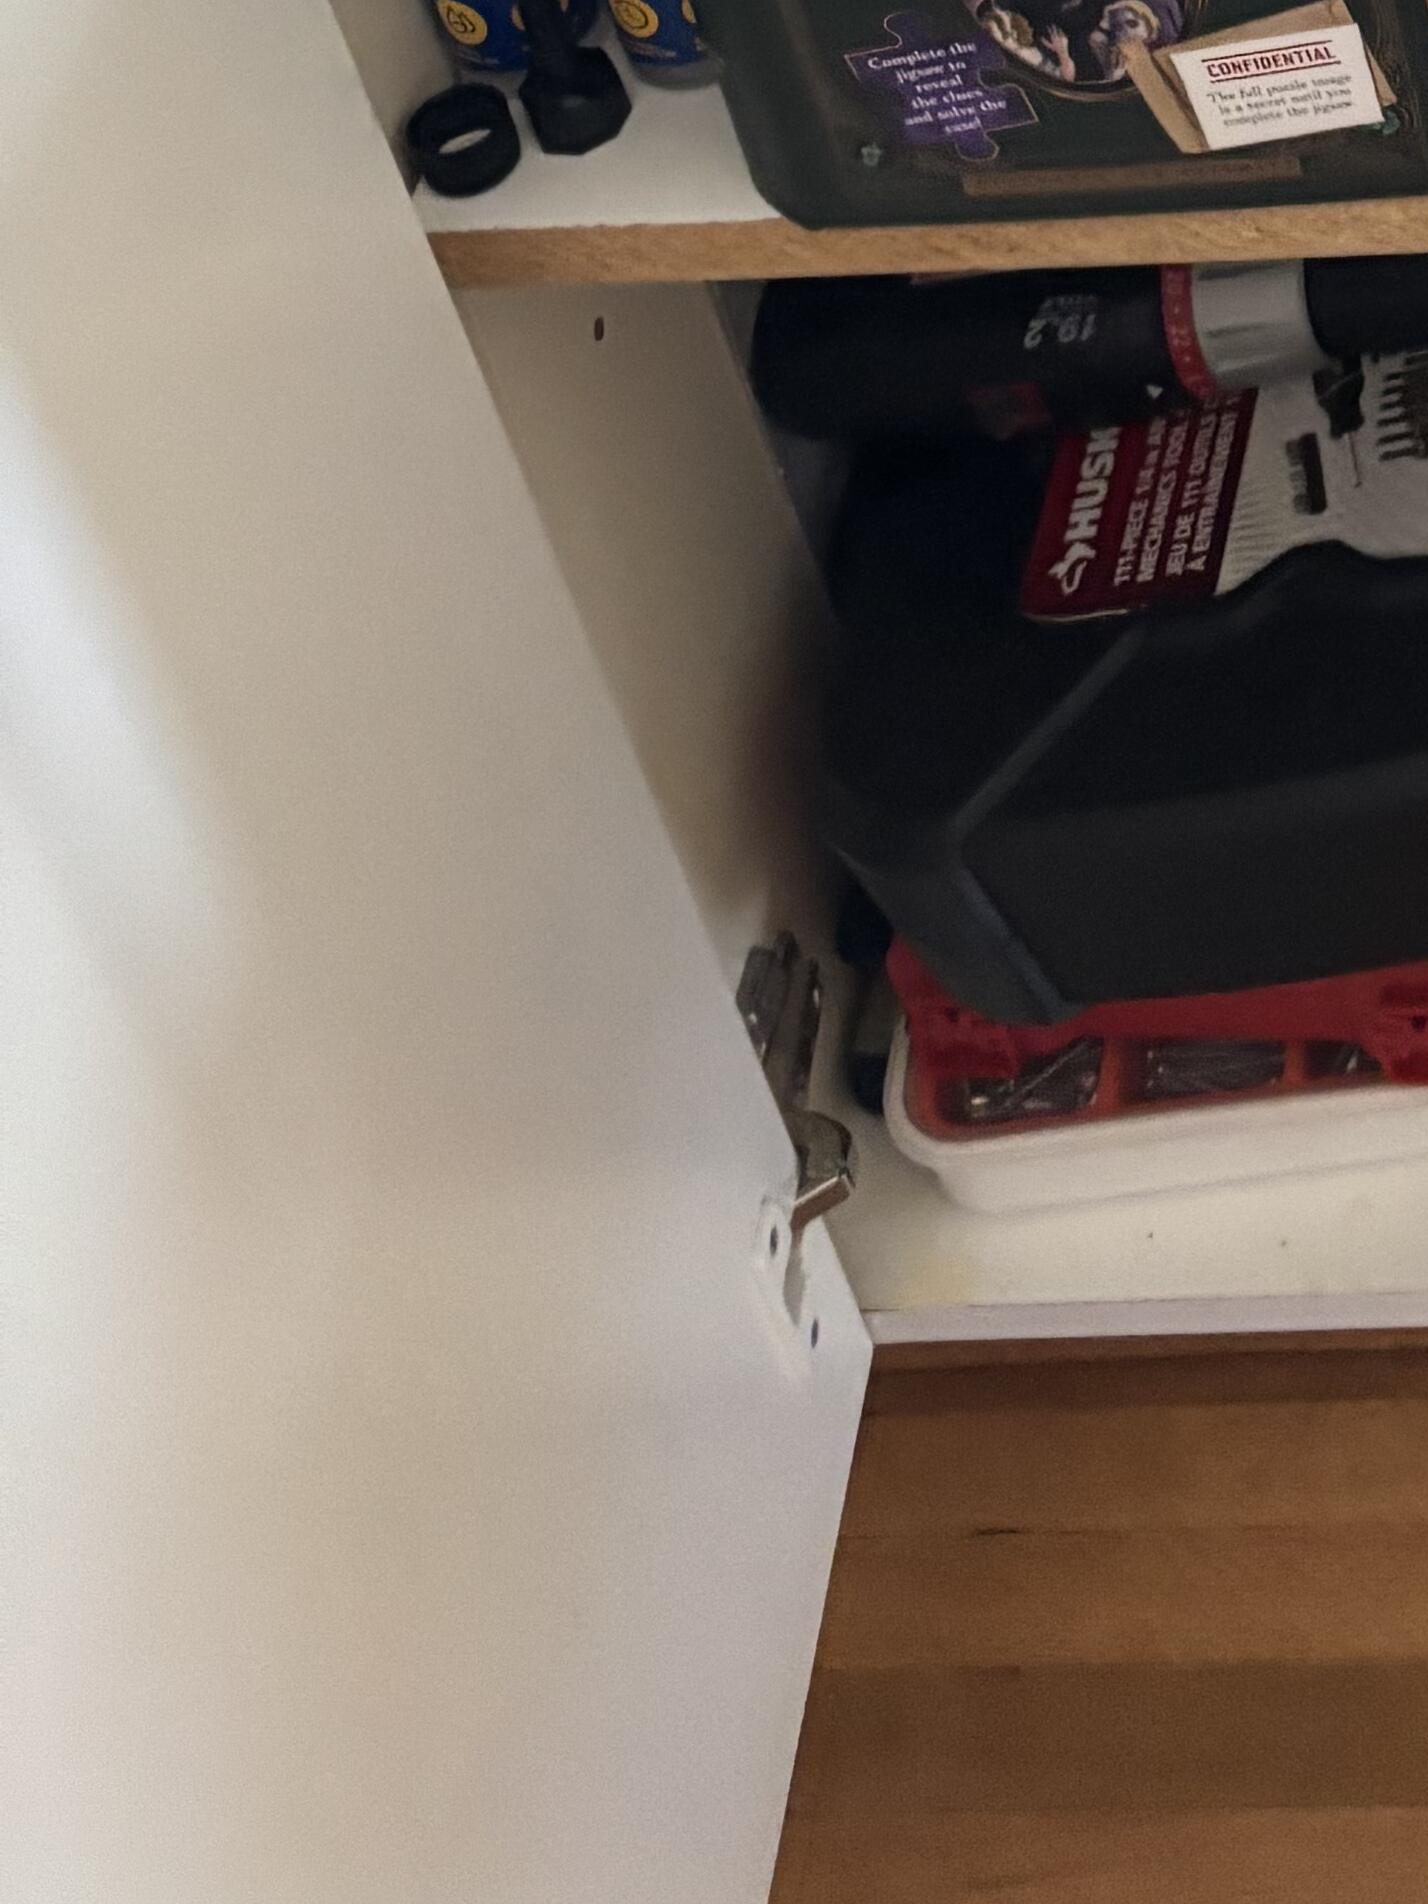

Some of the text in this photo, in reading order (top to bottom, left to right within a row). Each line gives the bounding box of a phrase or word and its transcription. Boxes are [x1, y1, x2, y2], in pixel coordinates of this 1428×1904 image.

[868, 42, 977, 70] Complete the
[948, 61, 966, 73] to
[1206, 45, 1337, 79] CONFIDENTIAL
[915, 74, 963, 93] reveal
[1206, 73, 1352, 105] The full puzzle image
[904, 98, 1007, 126] and solve the
[911, 89, 984, 110] the clues
[1247, 96, 1287, 110] secret
[1290, 90, 1322, 104] until
[1223, 110, 1284, 127] complete
[1287, 103, 1310, 118] the
[1064, 426, 1122, 543] HUSK
[1181, 481, 1203, 510] 111
[1137, 469, 1179, 584] MECHANICS
[1175, 511, 1196, 539] DE
[1165, 542, 1188, 578] JEU
